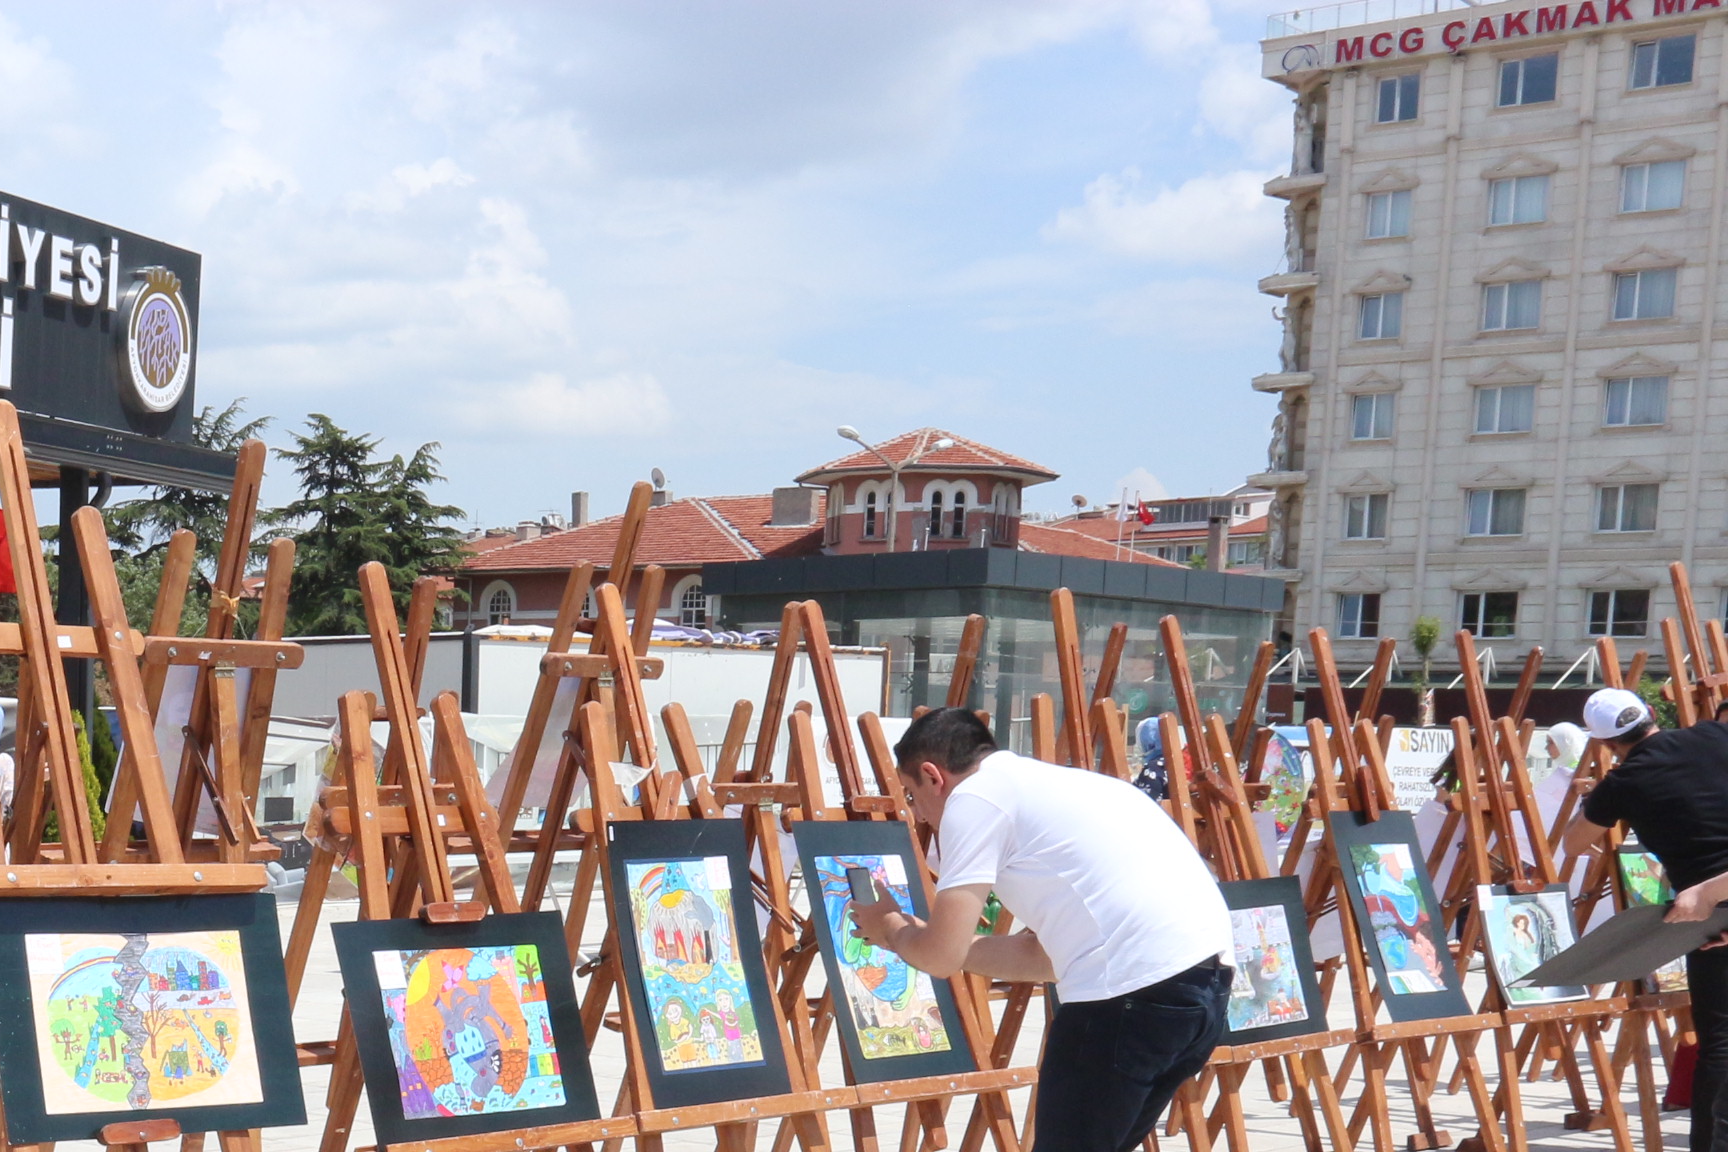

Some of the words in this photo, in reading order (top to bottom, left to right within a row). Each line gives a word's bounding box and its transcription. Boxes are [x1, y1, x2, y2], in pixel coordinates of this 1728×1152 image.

[1335, 27, 1424, 63] MCG
[1441, 0, 1633, 53] ÇAKMAK
[1410, 730, 1450, 753] SAYIN
